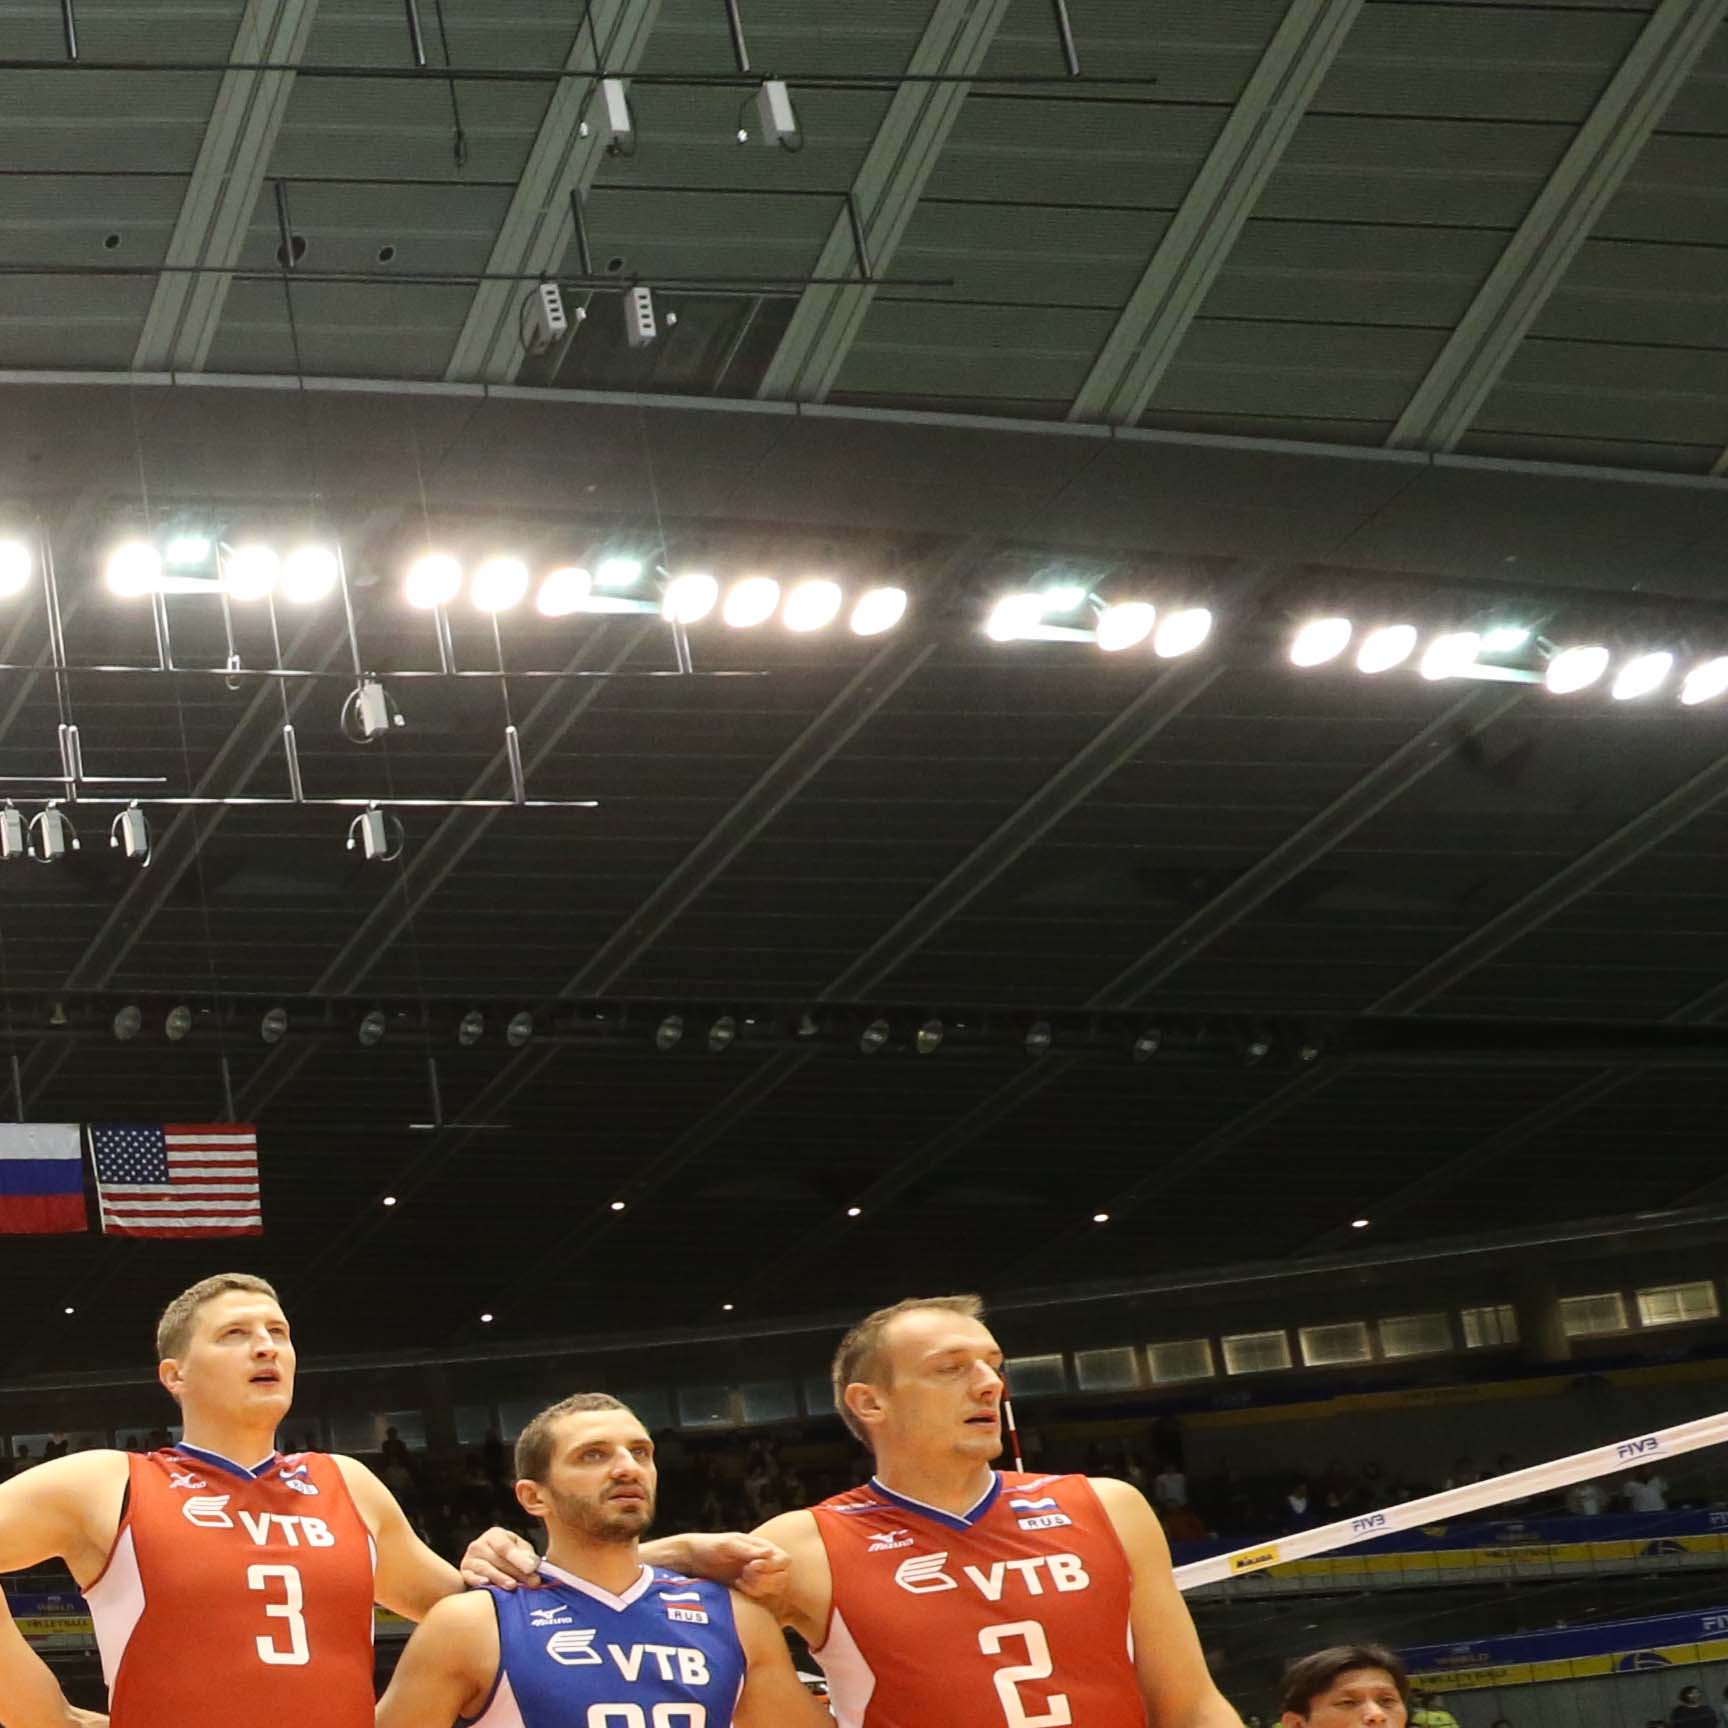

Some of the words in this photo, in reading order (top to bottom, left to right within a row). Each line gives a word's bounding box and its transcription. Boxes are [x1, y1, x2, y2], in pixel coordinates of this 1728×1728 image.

[1617, 1437, 1659, 1459] FIVB
[238, 1510, 335, 1547] VTB
[1028, 1513, 1065, 1529] RUS
[1352, 1514, 1386, 1532] FIVB
[963, 1553, 1089, 1601] VTB
[247, 1564, 311, 1665] 3
[675, 1610, 703, 1622] RUS
[607, 1644, 711, 1685] VTB
